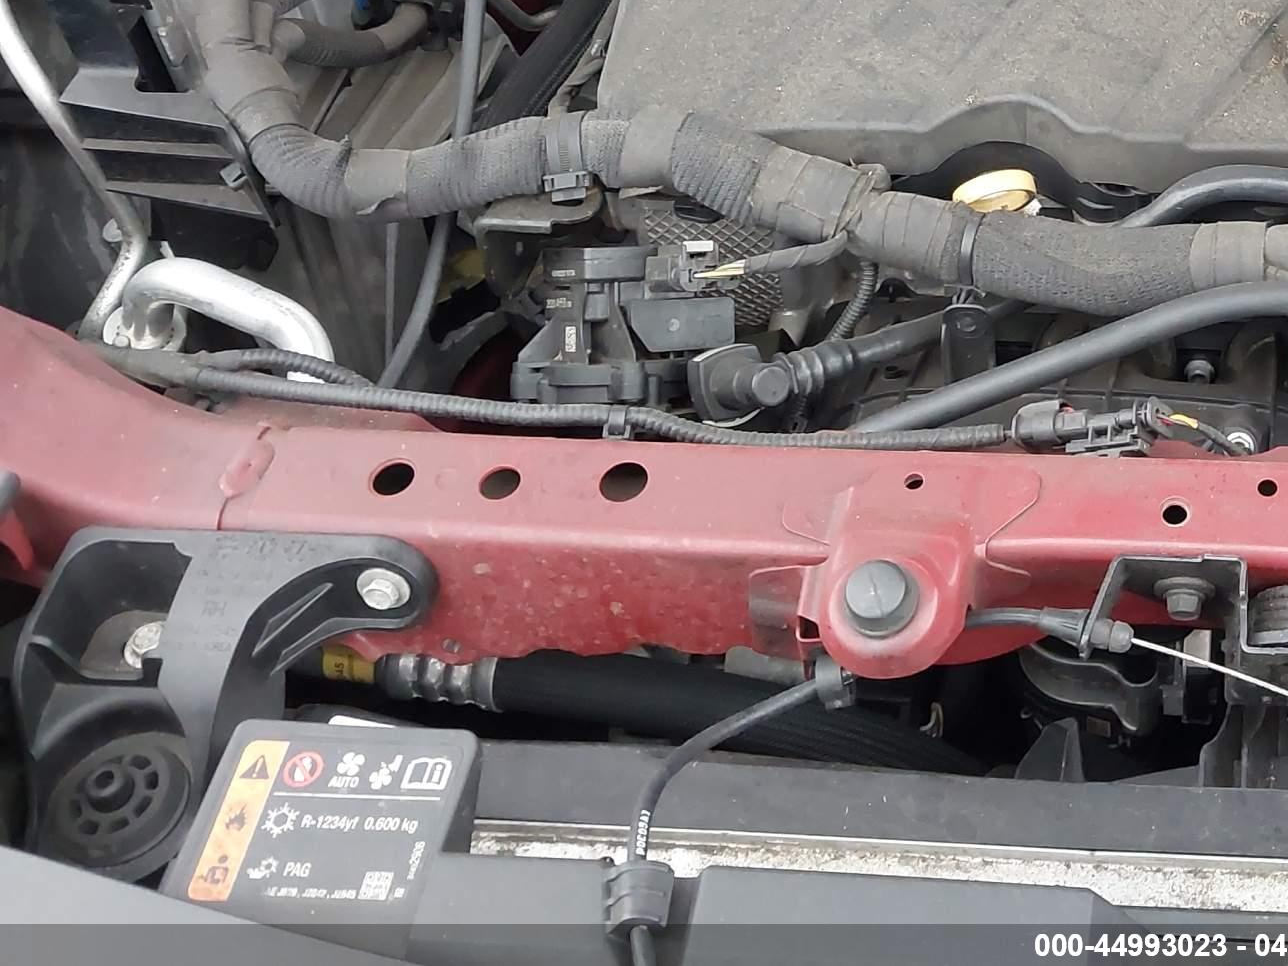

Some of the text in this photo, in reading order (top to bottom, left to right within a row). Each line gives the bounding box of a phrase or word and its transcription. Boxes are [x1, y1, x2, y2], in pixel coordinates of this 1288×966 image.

[328, 775, 359, 789] AUTO
[300, 814, 419, 834] R-1234yf 0.600 kg
[283, 862, 312, 878] PAG
